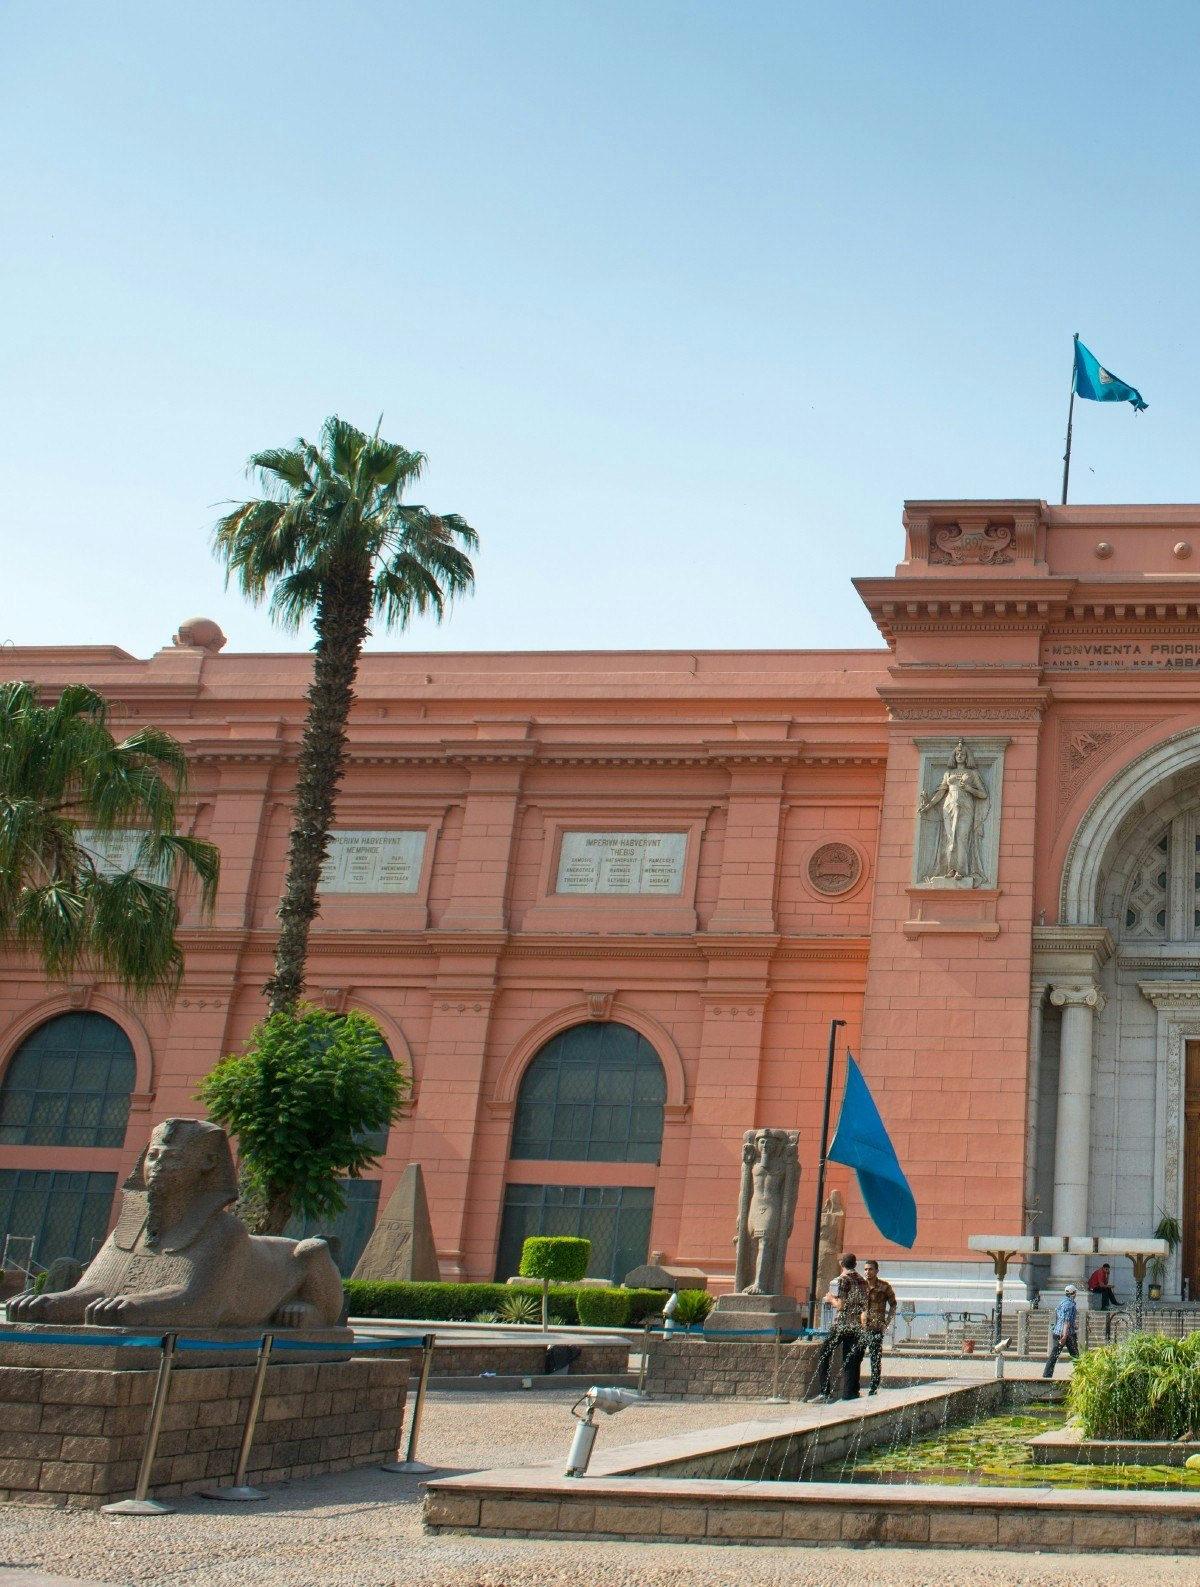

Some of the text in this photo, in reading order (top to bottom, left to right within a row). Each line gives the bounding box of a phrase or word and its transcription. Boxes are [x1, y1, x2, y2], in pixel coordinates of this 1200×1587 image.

[1053, 645, 1141, 655] MONVMENTA
[586, 838, 662, 847] IMPERIVM HABVERVNT
[610, 848, 635, 856] THEBIS
